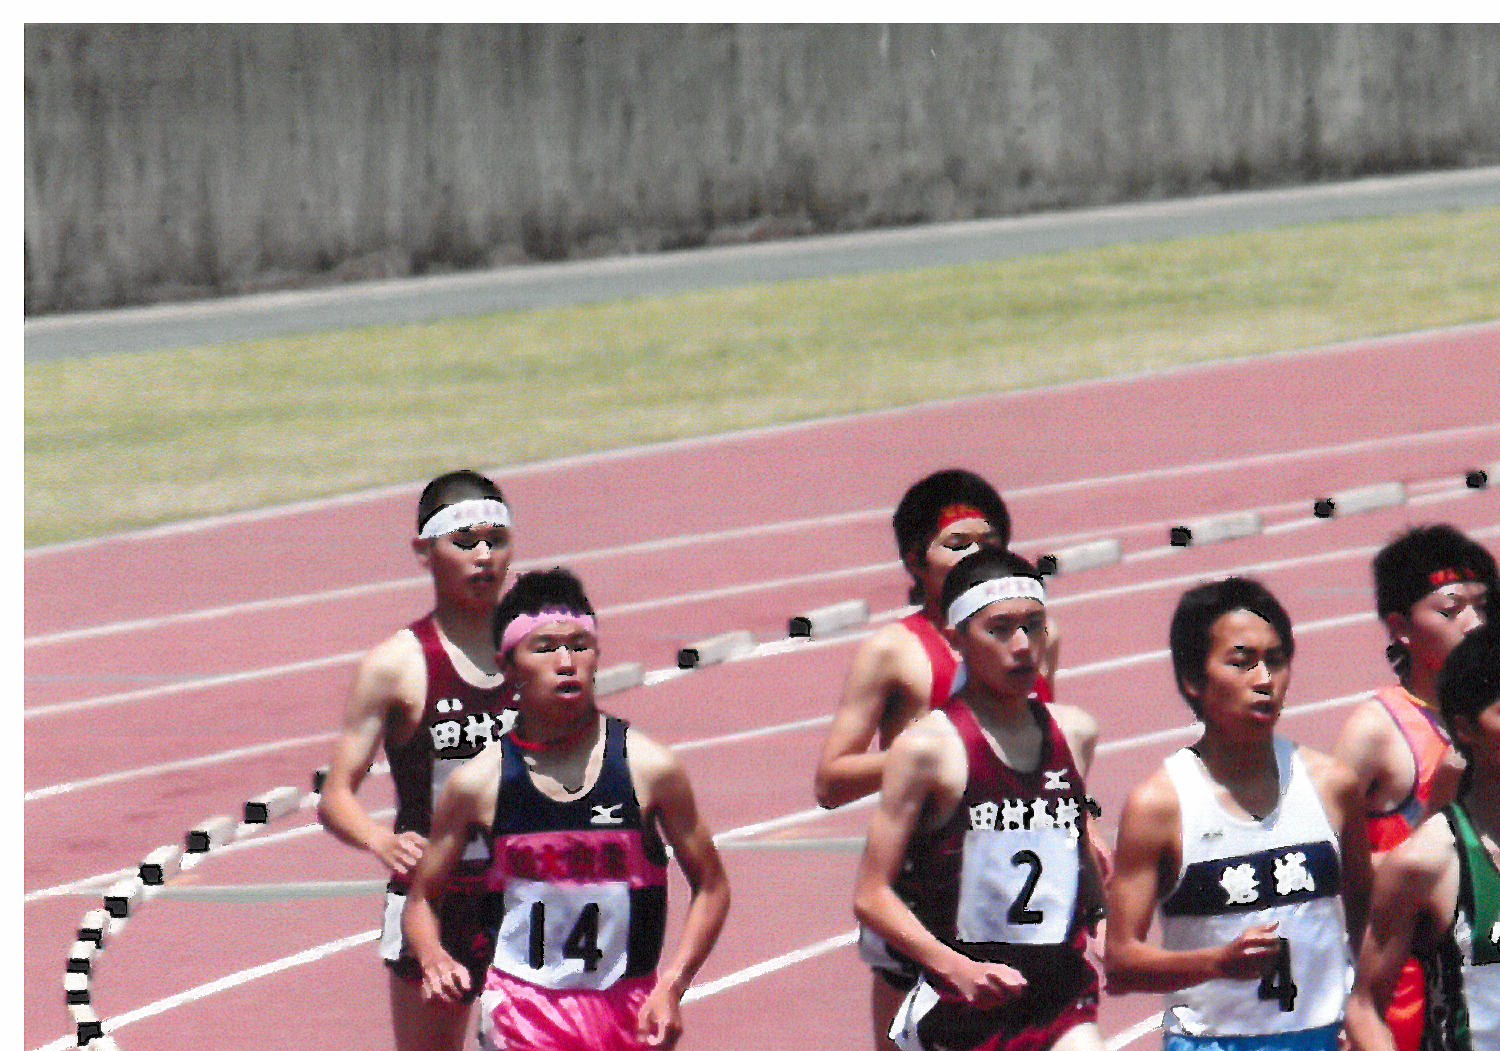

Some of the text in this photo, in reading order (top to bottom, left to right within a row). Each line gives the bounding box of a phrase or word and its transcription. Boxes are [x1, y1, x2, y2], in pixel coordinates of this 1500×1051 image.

[1007, 849, 1044, 926] 2
[528, 901, 603, 971] 14
[1257, 936, 1298, 1012] 4
